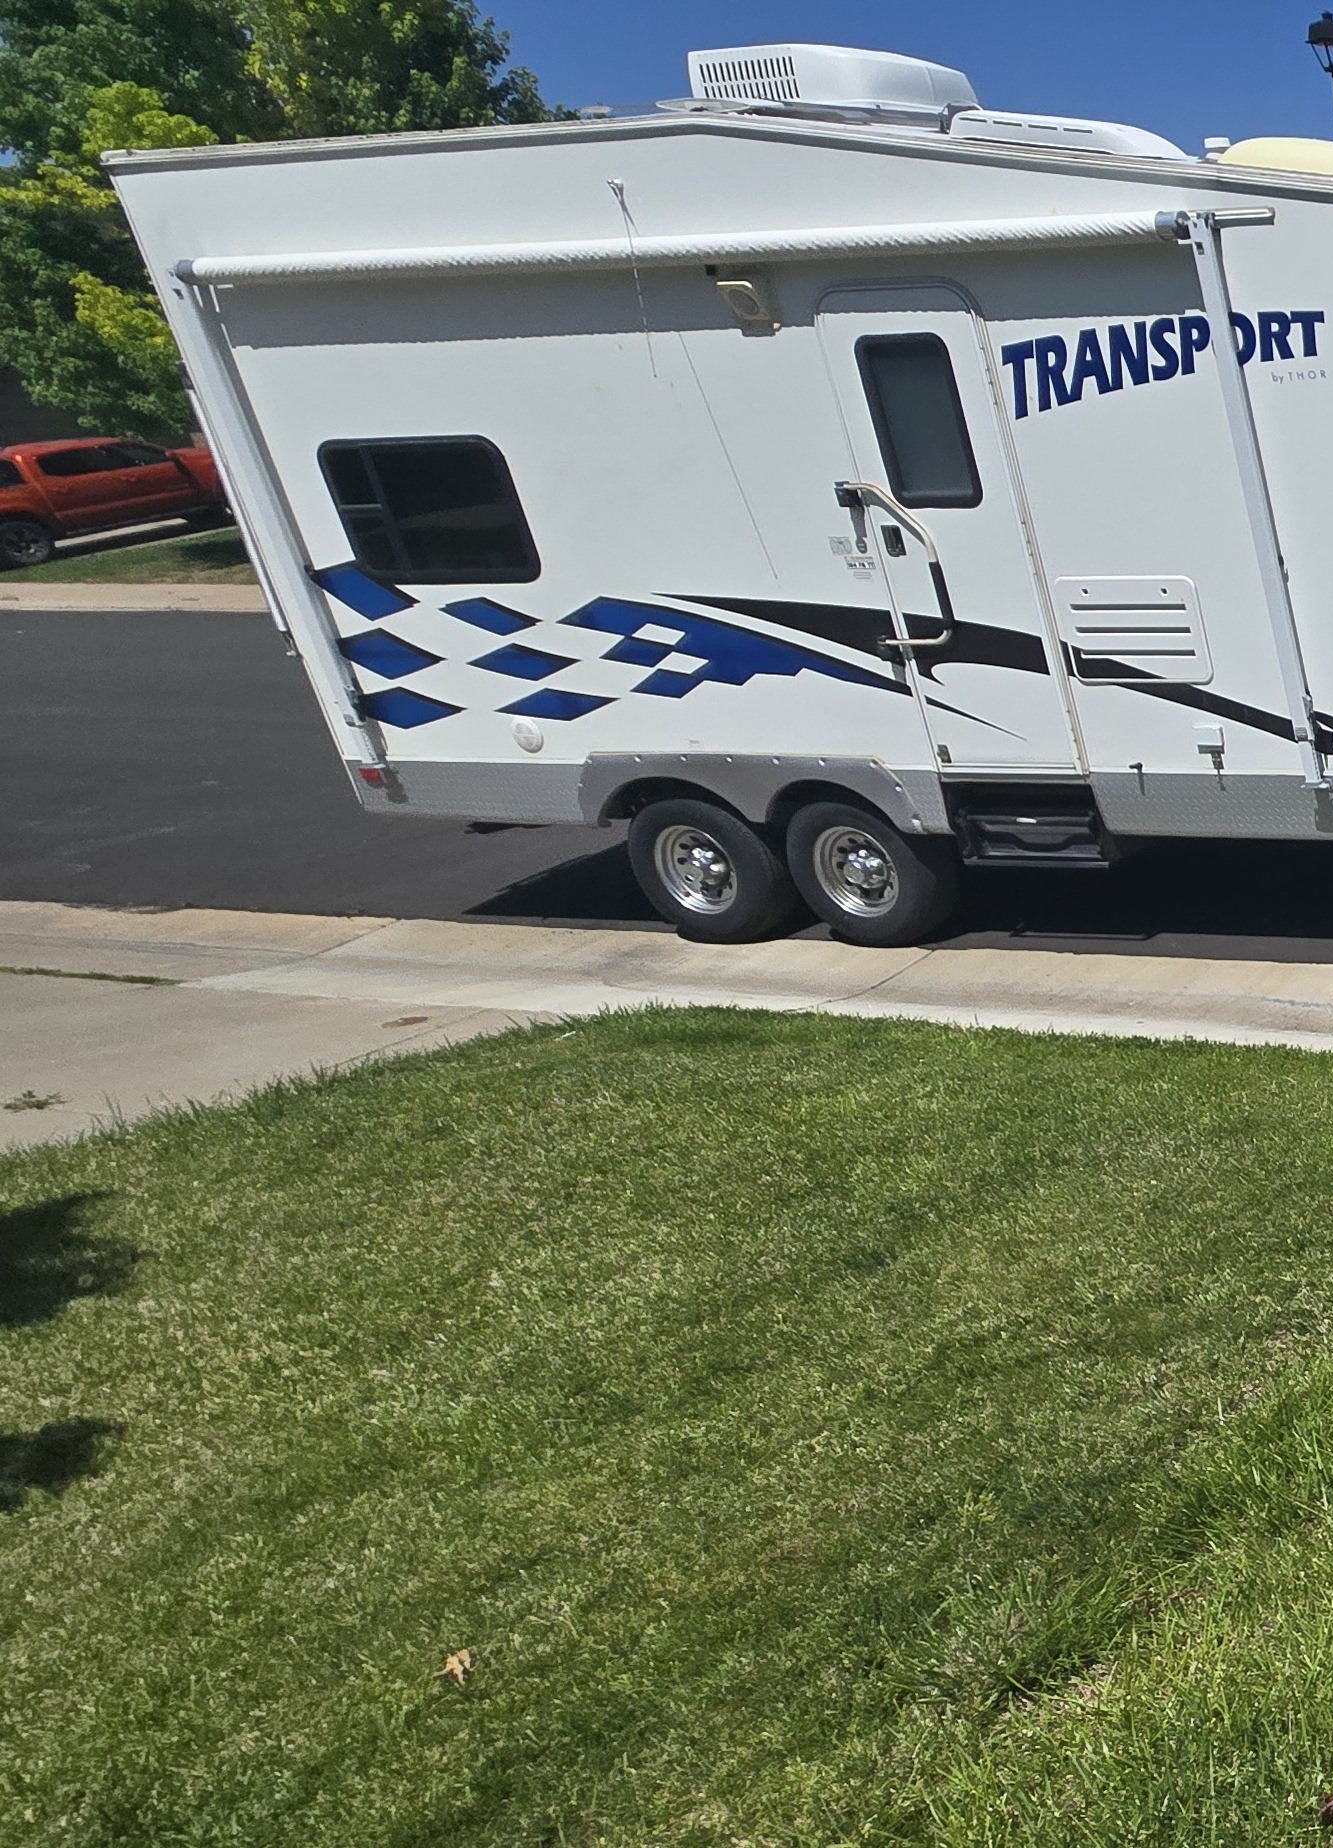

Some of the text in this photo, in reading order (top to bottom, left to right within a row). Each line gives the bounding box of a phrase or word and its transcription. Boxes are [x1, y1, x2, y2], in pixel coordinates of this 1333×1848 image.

[1001, 310, 1325, 420] TRANSPORT
[1271, 369, 1327, 385] by THOR
